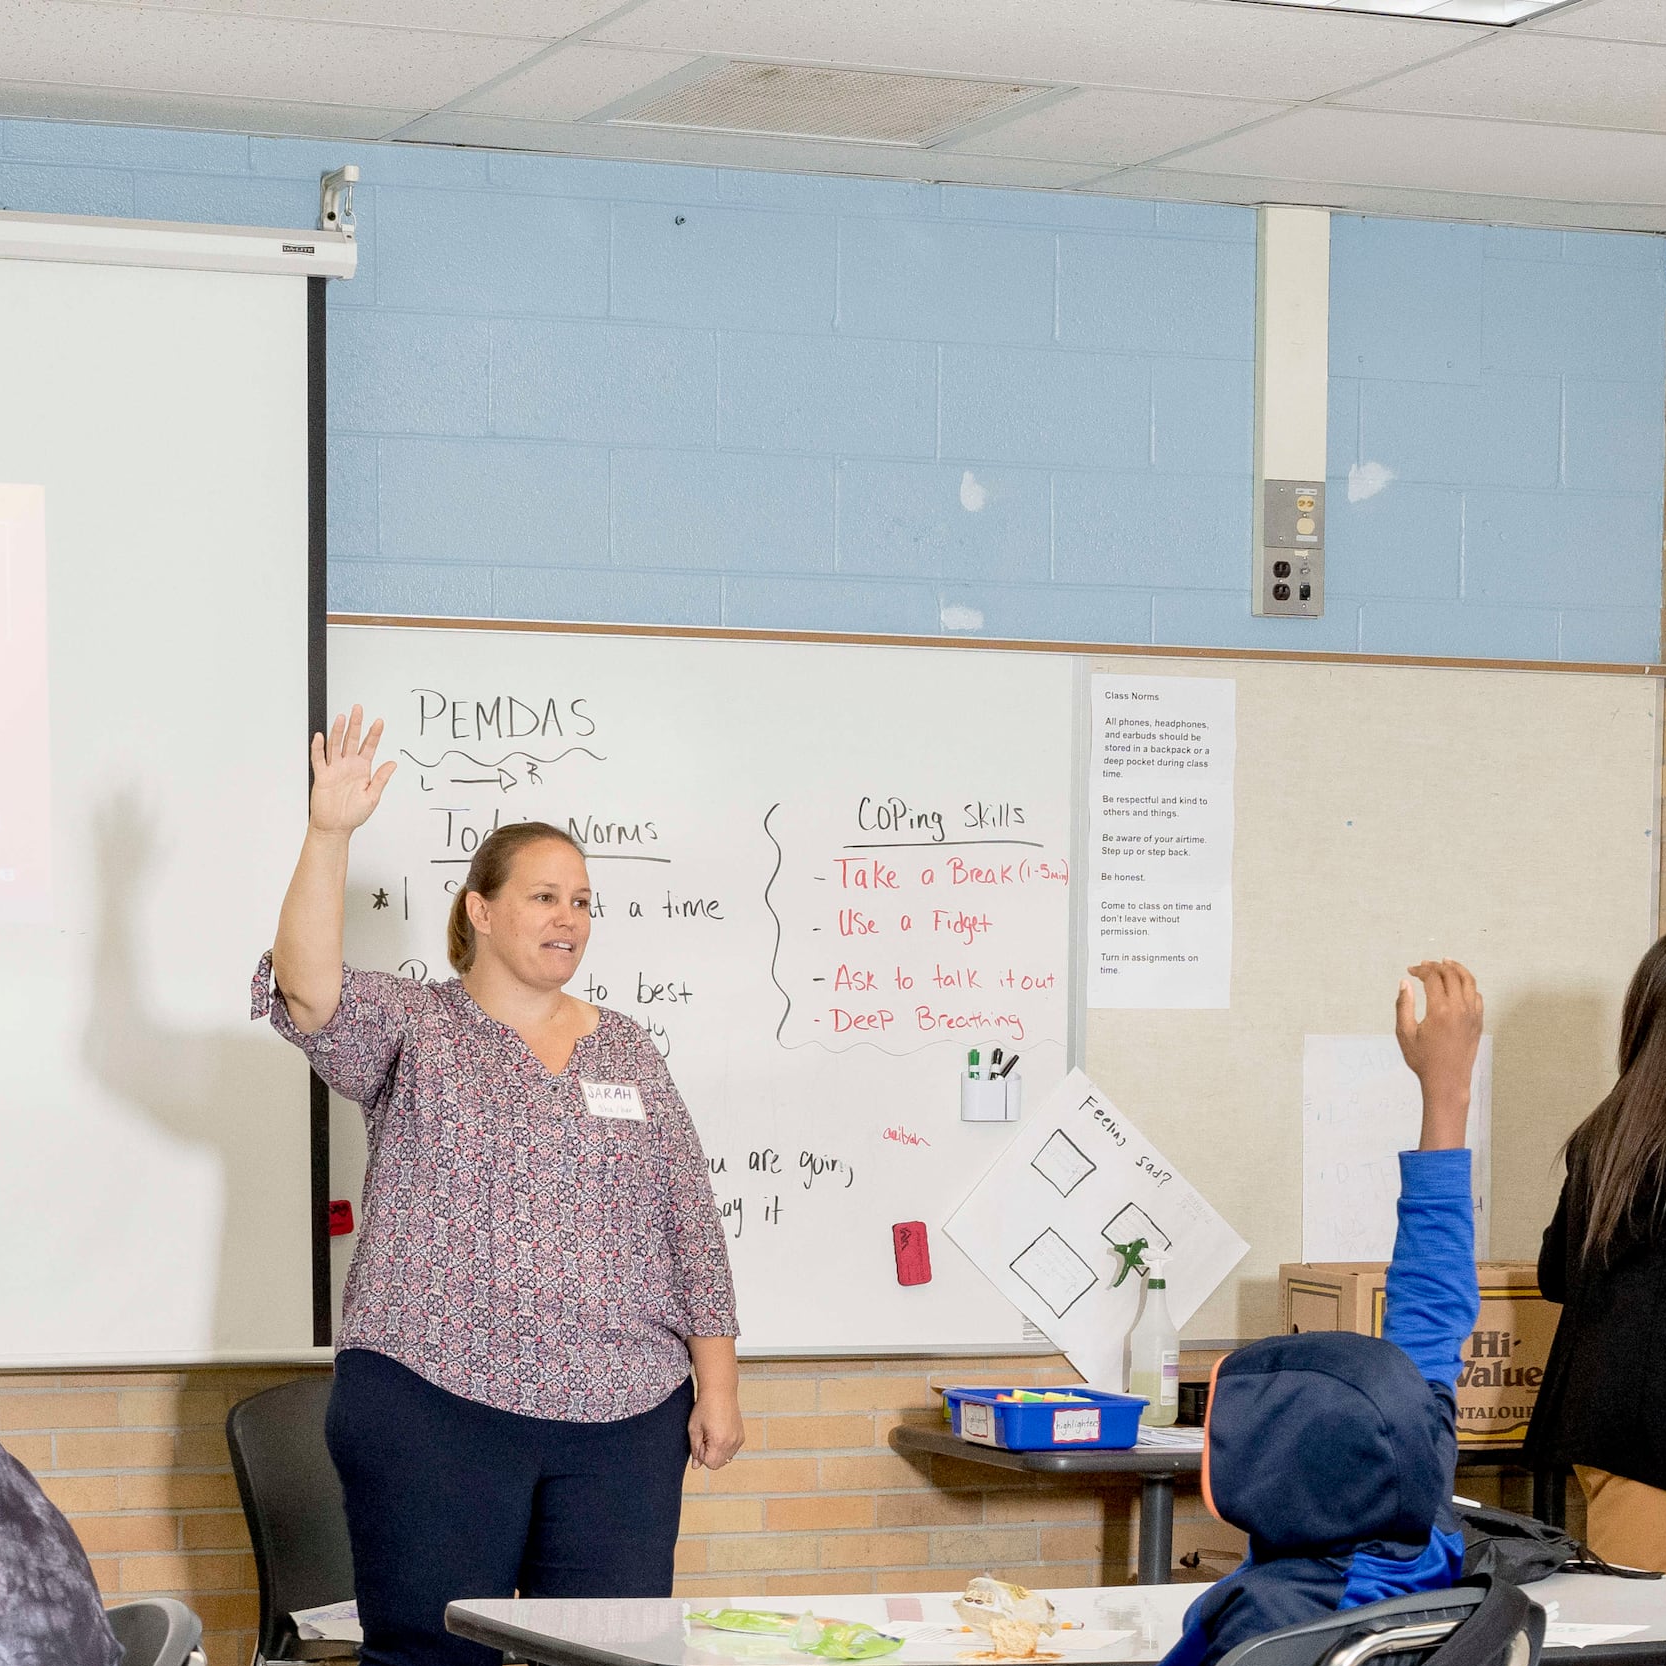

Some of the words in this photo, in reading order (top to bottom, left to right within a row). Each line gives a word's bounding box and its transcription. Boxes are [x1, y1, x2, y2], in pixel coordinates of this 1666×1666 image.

[1105, 692, 1129, 700] Class
[1132, 692, 1159, 700] Norms
[411, 689, 596, 740] PEMDAS
[1119, 718, 1152, 727] phones,
[1155, 719, 1209, 729] headphones,
[1105, 744, 1130, 752] stored
[1151, 746, 1191, 754] backpack
[1104, 758, 1124, 766] deep
[1127, 758, 1155, 766] pocket
[1157, 759, 1184, 768] during
[1103, 795, 1113, 803] Be
[1117, 796, 1158, 805] respectful
[1151, 809, 1179, 818] things.
[569, 815, 658, 845] Norms
[1154, 836, 1173, 844] your
[1102, 847, 1120, 855] Step
[1148, 849, 1165, 857] step
[1169, 848, 1190, 856] back.
[833, 857, 900, 890] Take
[921, 868, 935, 884] a
[946, 857, 1014, 885] Break
[1115, 873, 1145, 881] honest.
[629, 900, 643, 919] a
[662, 890, 726, 922] time
[1101, 901, 1125, 909] Come
[1139, 902, 1160, 910] class
[1149, 915, 1180, 923] without
[900, 915, 912, 931] a
[933, 909, 993, 946] Fidget
[1101, 928, 1149, 936] permission.
[1101, 953, 1119, 961] Turn
[1132, 954, 1185, 963] assignments
[835, 964, 879, 991] Ask
[894, 967, 914, 989] to
[933, 964, 982, 989] talk
[999, 968, 1014, 989] it
[1020, 973, 1055, 990] out
[583, 973, 608, 1002] to
[636, 971, 693, 1005] best
[915, 1006, 1024, 1041] Breathing
[587, 1087, 632, 1101] SARAH
[749, 1149, 782, 1174] are
[764, 1195, 785, 1225] it
[1456, 1360, 1543, 1388] Value
[1056, 1417, 1100, 1436] highlighters
